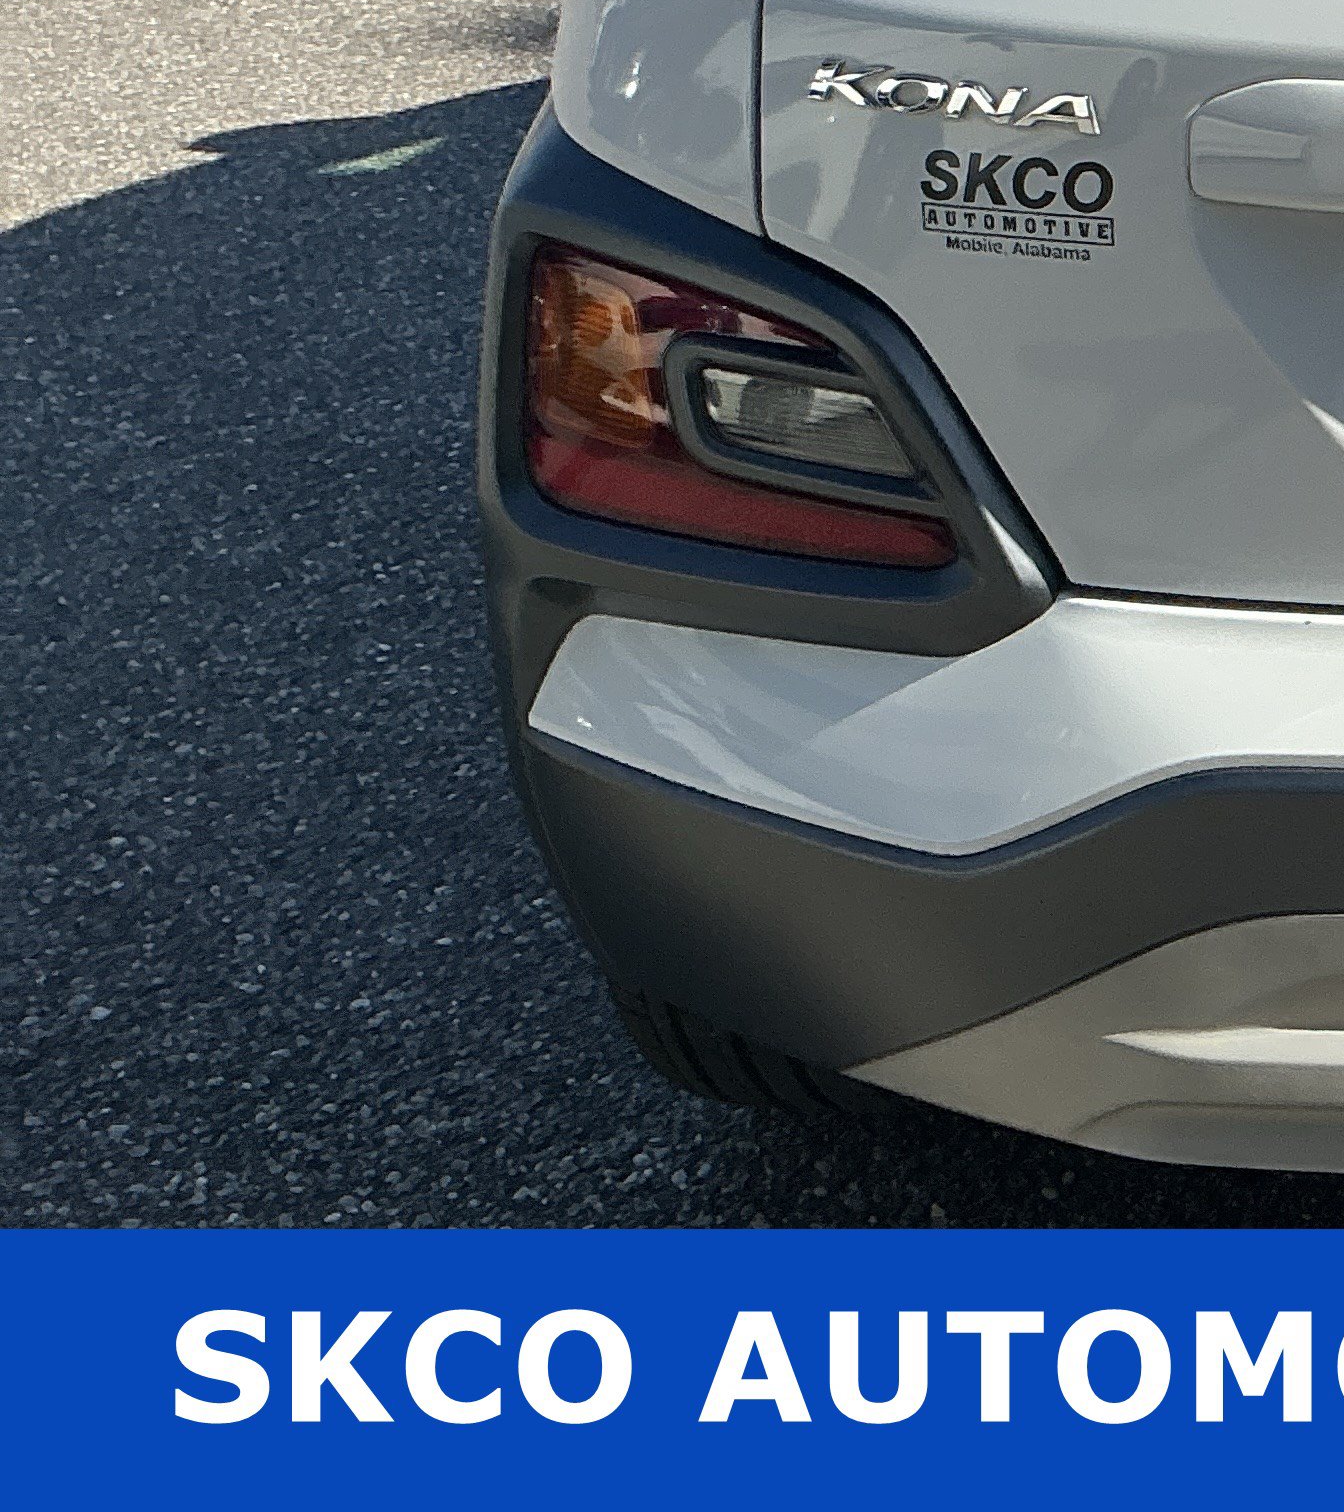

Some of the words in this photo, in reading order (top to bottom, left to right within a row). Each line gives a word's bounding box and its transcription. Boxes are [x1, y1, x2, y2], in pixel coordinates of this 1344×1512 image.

[808, 58, 1101, 136] KONA
[920, 149, 1114, 214] SKCO
[927, 208, 1110, 240] AUTOMOTIVE
[945, 236, 1008, 257] Mobile,
[1011, 240, 1091, 262] Alabama
